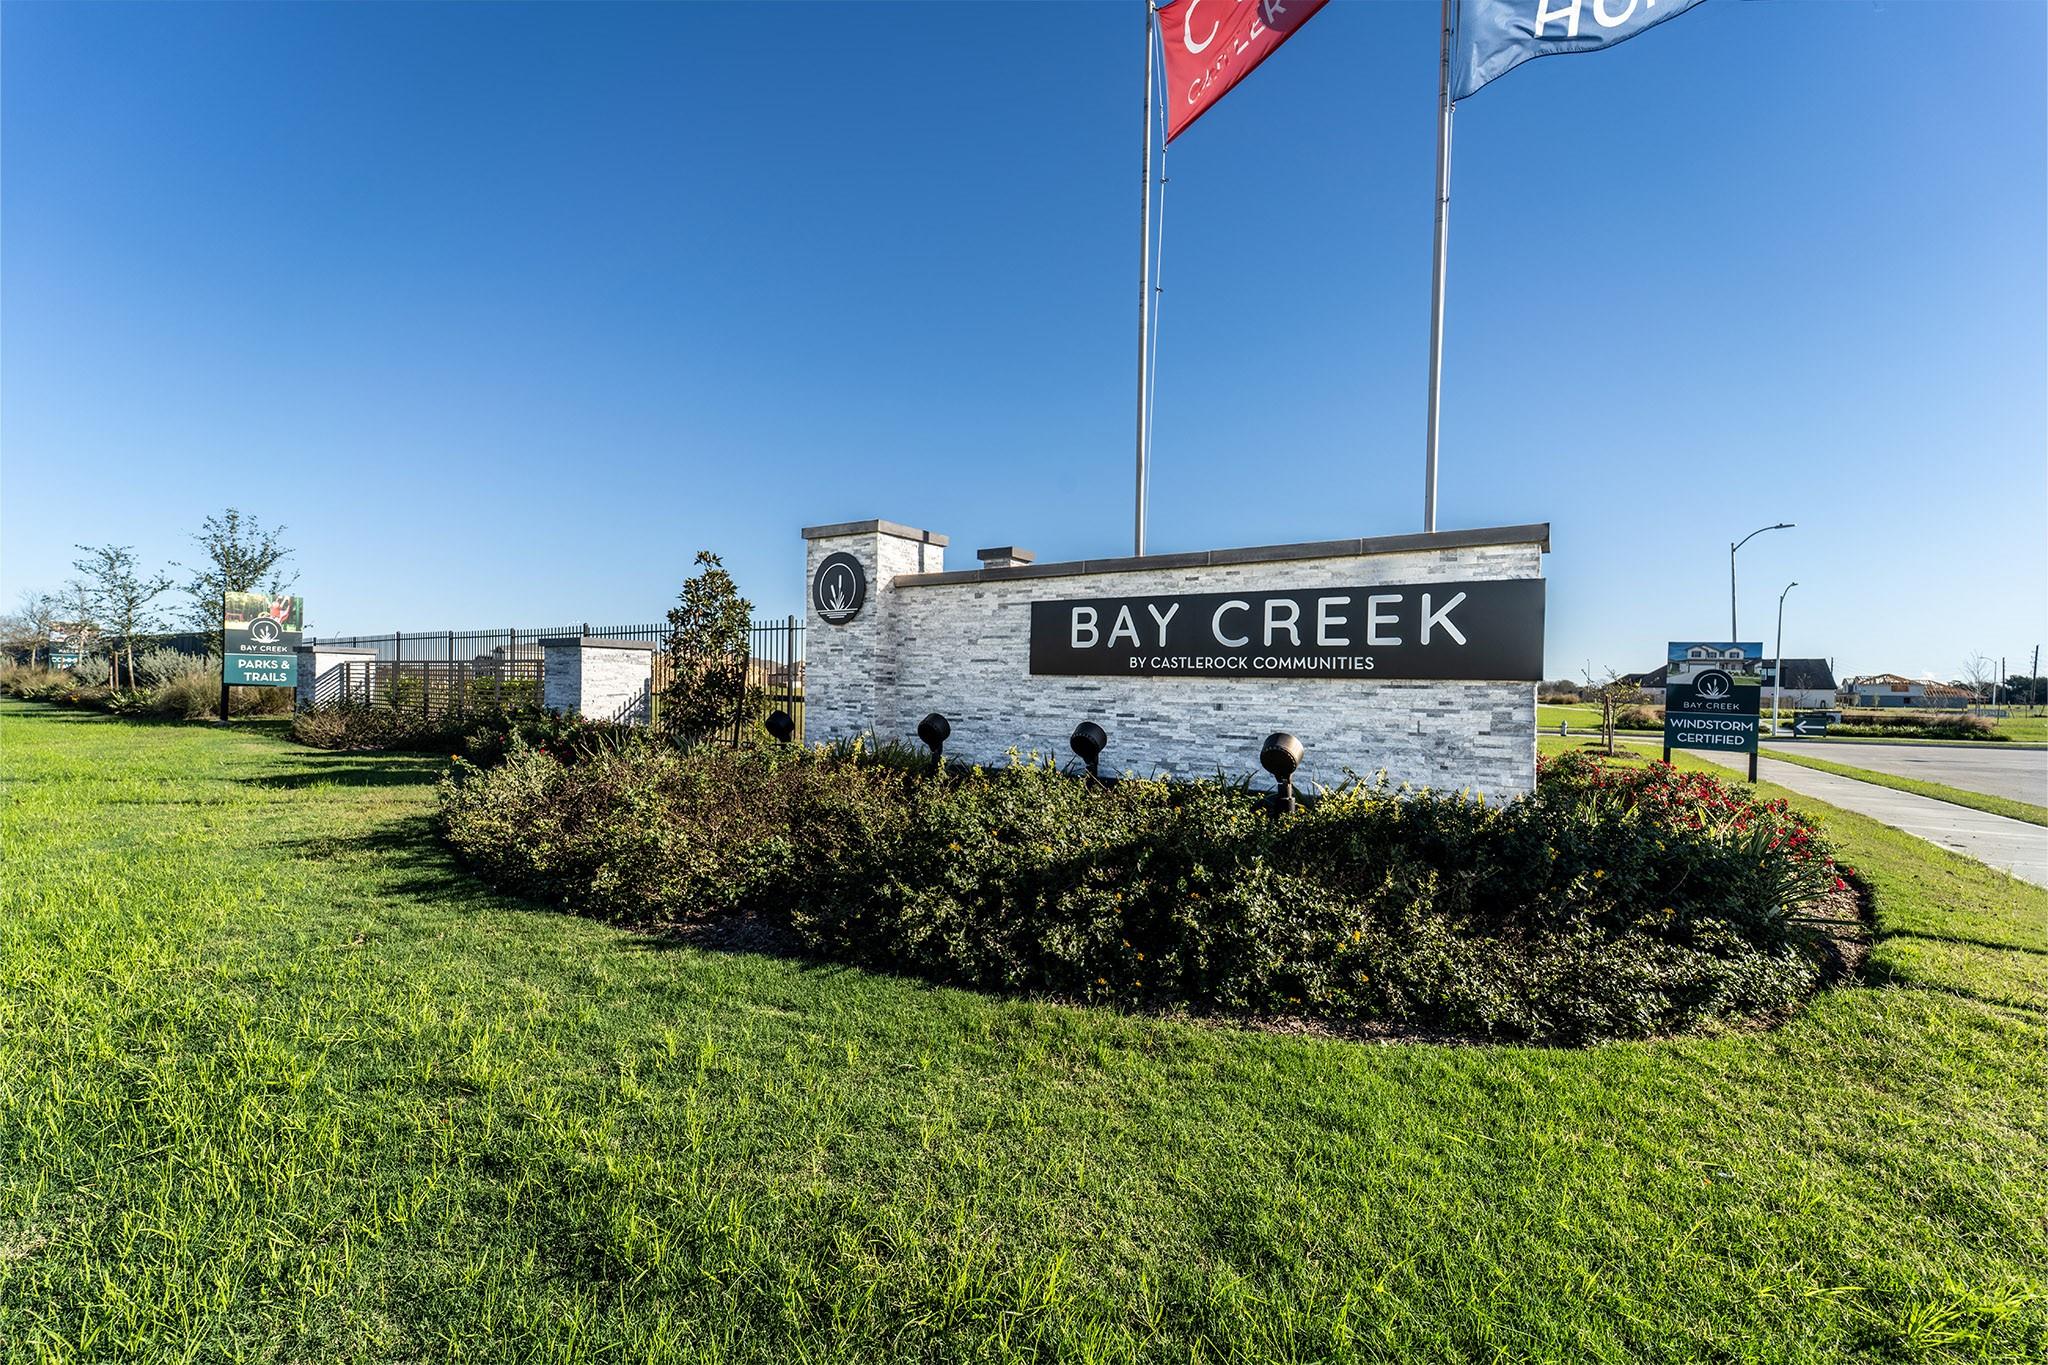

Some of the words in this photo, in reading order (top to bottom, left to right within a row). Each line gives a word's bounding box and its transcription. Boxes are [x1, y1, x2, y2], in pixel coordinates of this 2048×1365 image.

[1533, 0, 1655, 38] HO
[1071, 602, 1180, 648] BAY
[1211, 592, 1466, 647] CREEK
[238, 659, 279, 669] PARKS
[281, 660, 290, 669] &
[1129, 656, 1147, 668] BY
[1151, 656, 1248, 669] CASTLEROCK
[1253, 656, 1375, 670] COMMUNITIES
[244, 672, 287, 681] TRAILS
[1683, 701, 1703, 709] BAY
[1706, 702, 1740, 710] CREEK
[1670, 718, 1753, 731] WINDSTORM
[1677, 732, 1745, 745] CERTIFIED
